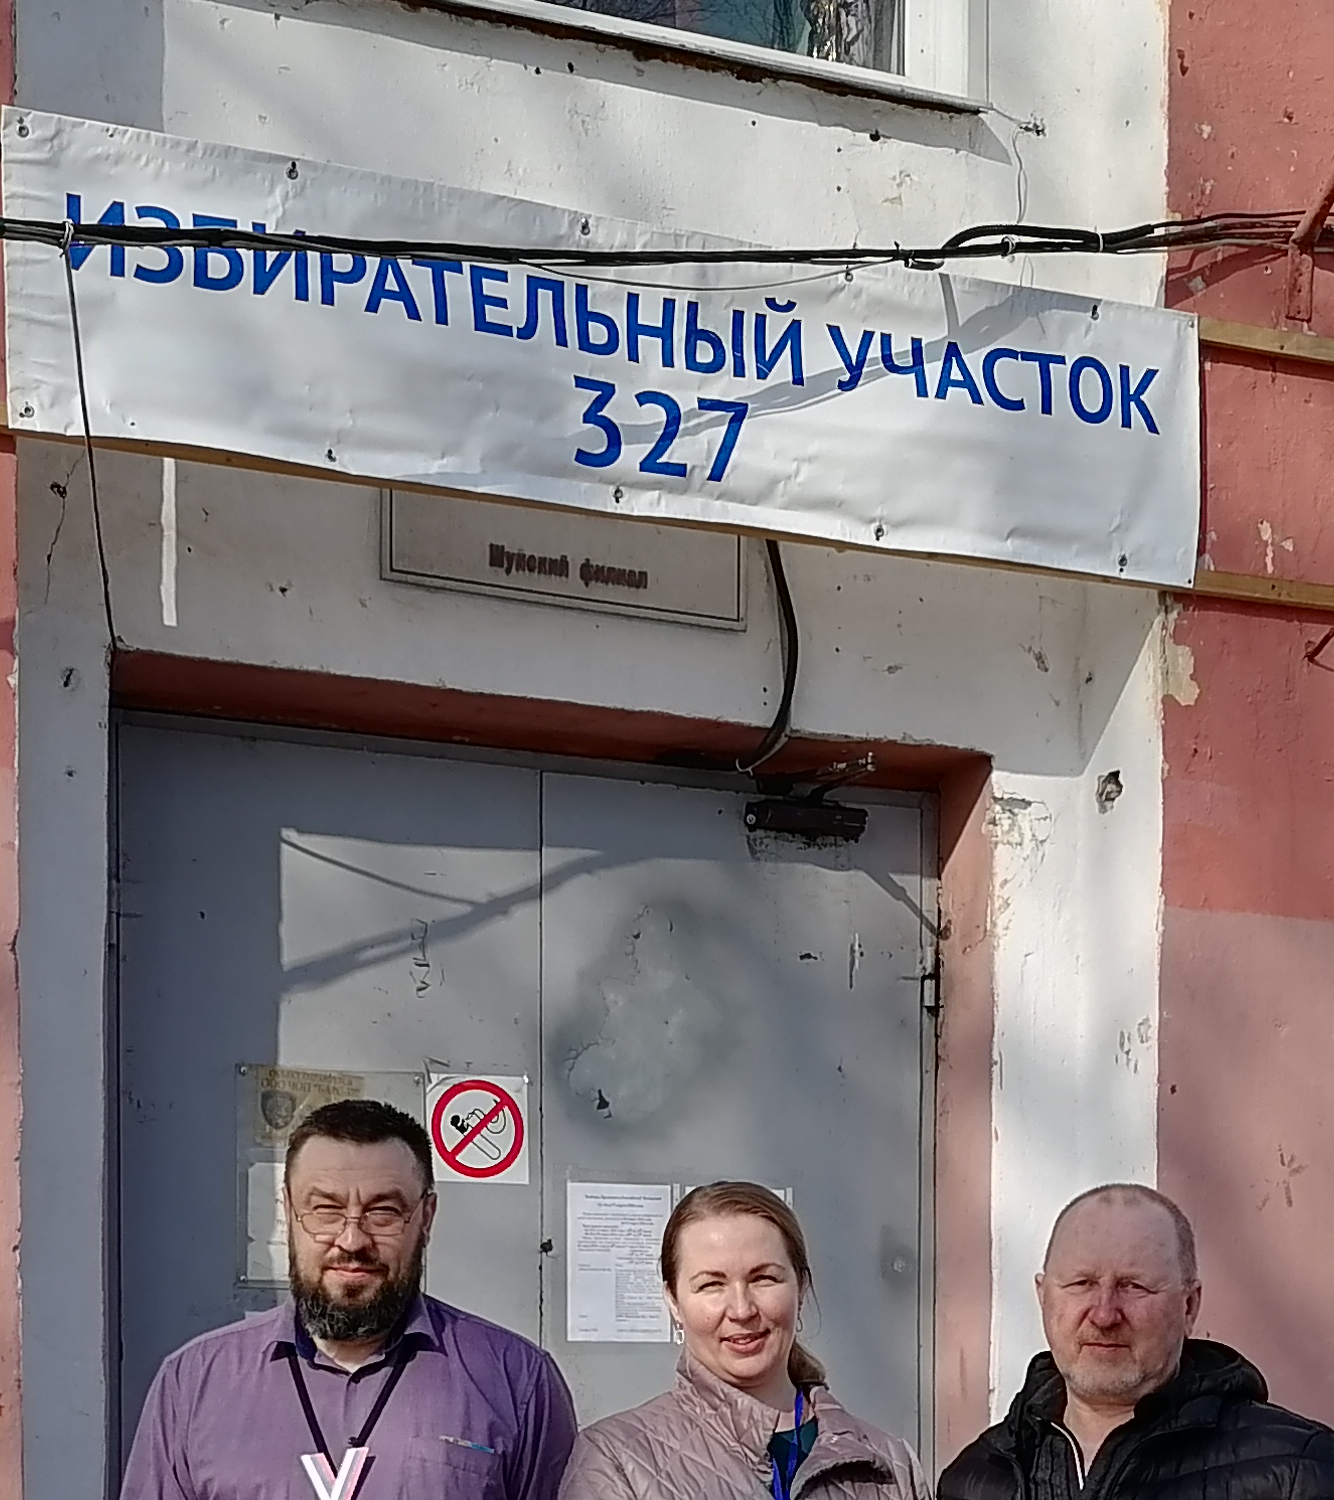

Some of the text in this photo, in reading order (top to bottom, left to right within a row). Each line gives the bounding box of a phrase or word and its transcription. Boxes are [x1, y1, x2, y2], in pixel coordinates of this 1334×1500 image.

[66, 192, 1162, 437] ИЗБИРАТЕЛЬНЫЙ УЧАСТОК
[572, 373, 752, 483] 327
[488, 542, 649, 590] Шуйский филиал
